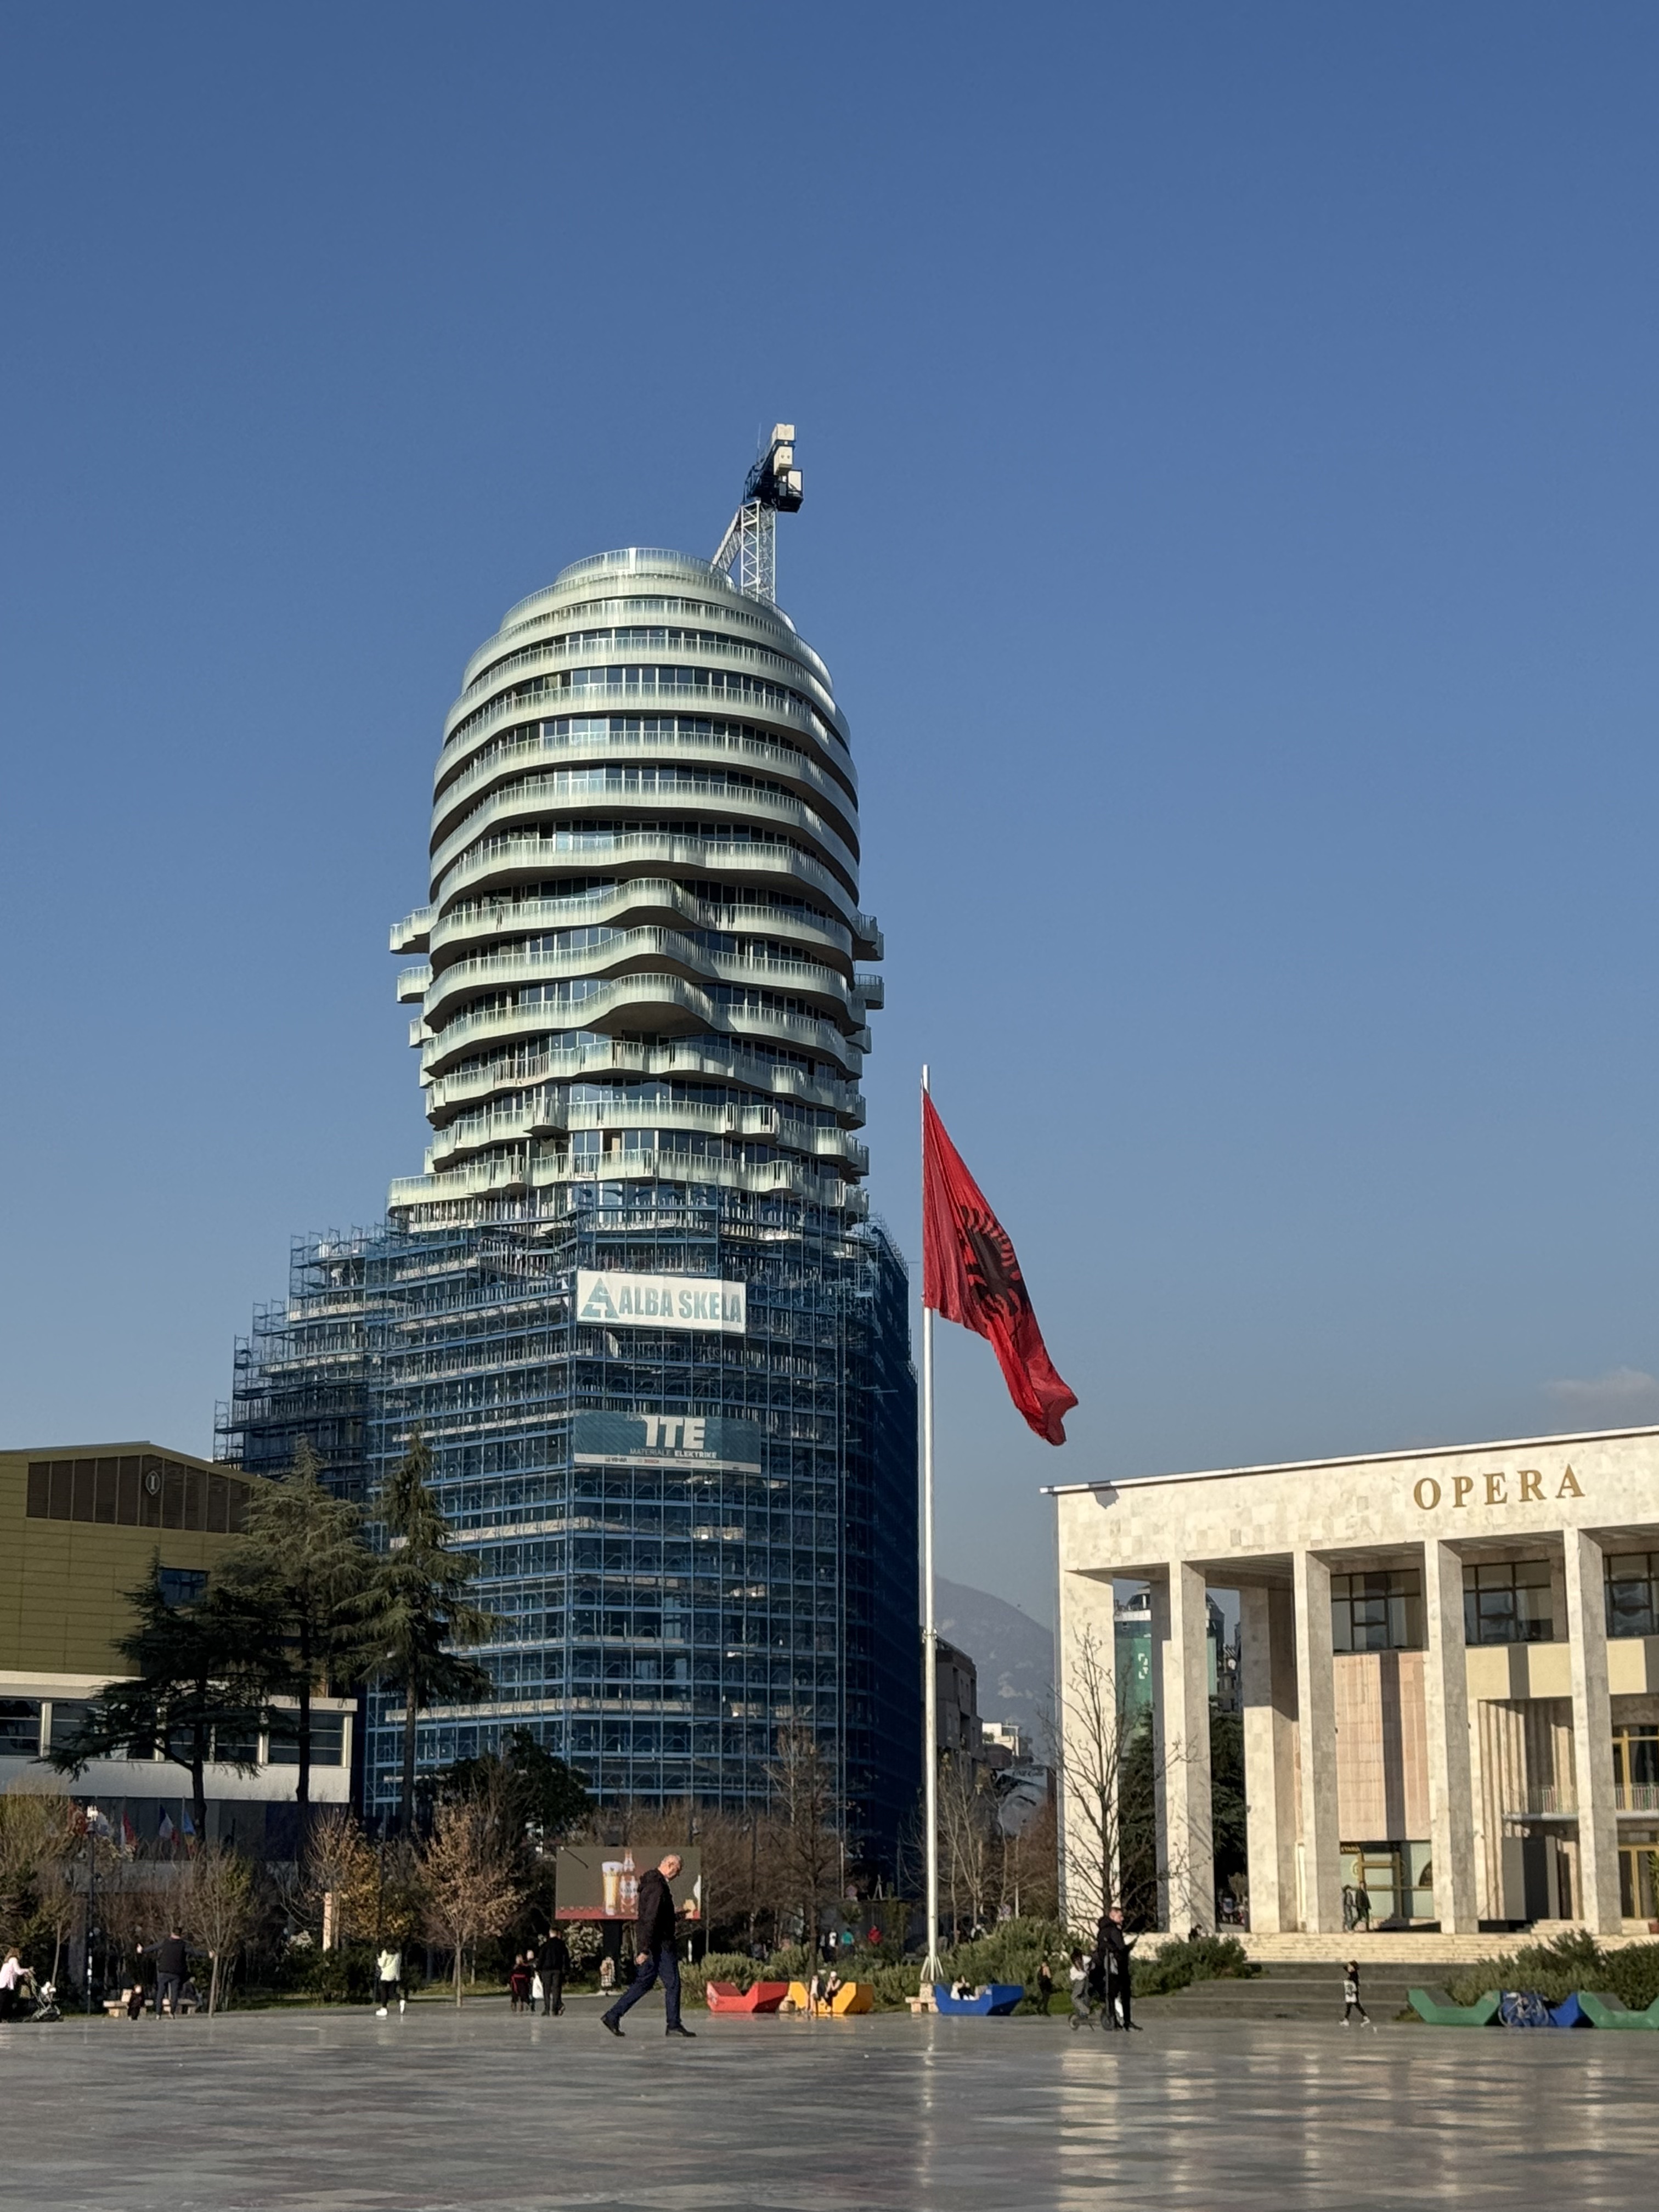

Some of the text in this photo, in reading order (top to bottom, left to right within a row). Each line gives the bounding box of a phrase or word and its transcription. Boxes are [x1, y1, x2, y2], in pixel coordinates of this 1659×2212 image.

[618, 1285, 742, 1323] ALBA SKELA
[630, 1447, 718, 1459] MATERIALE ELEKTRIKE
[1413, 1463, 1586, 1510] OPERA
